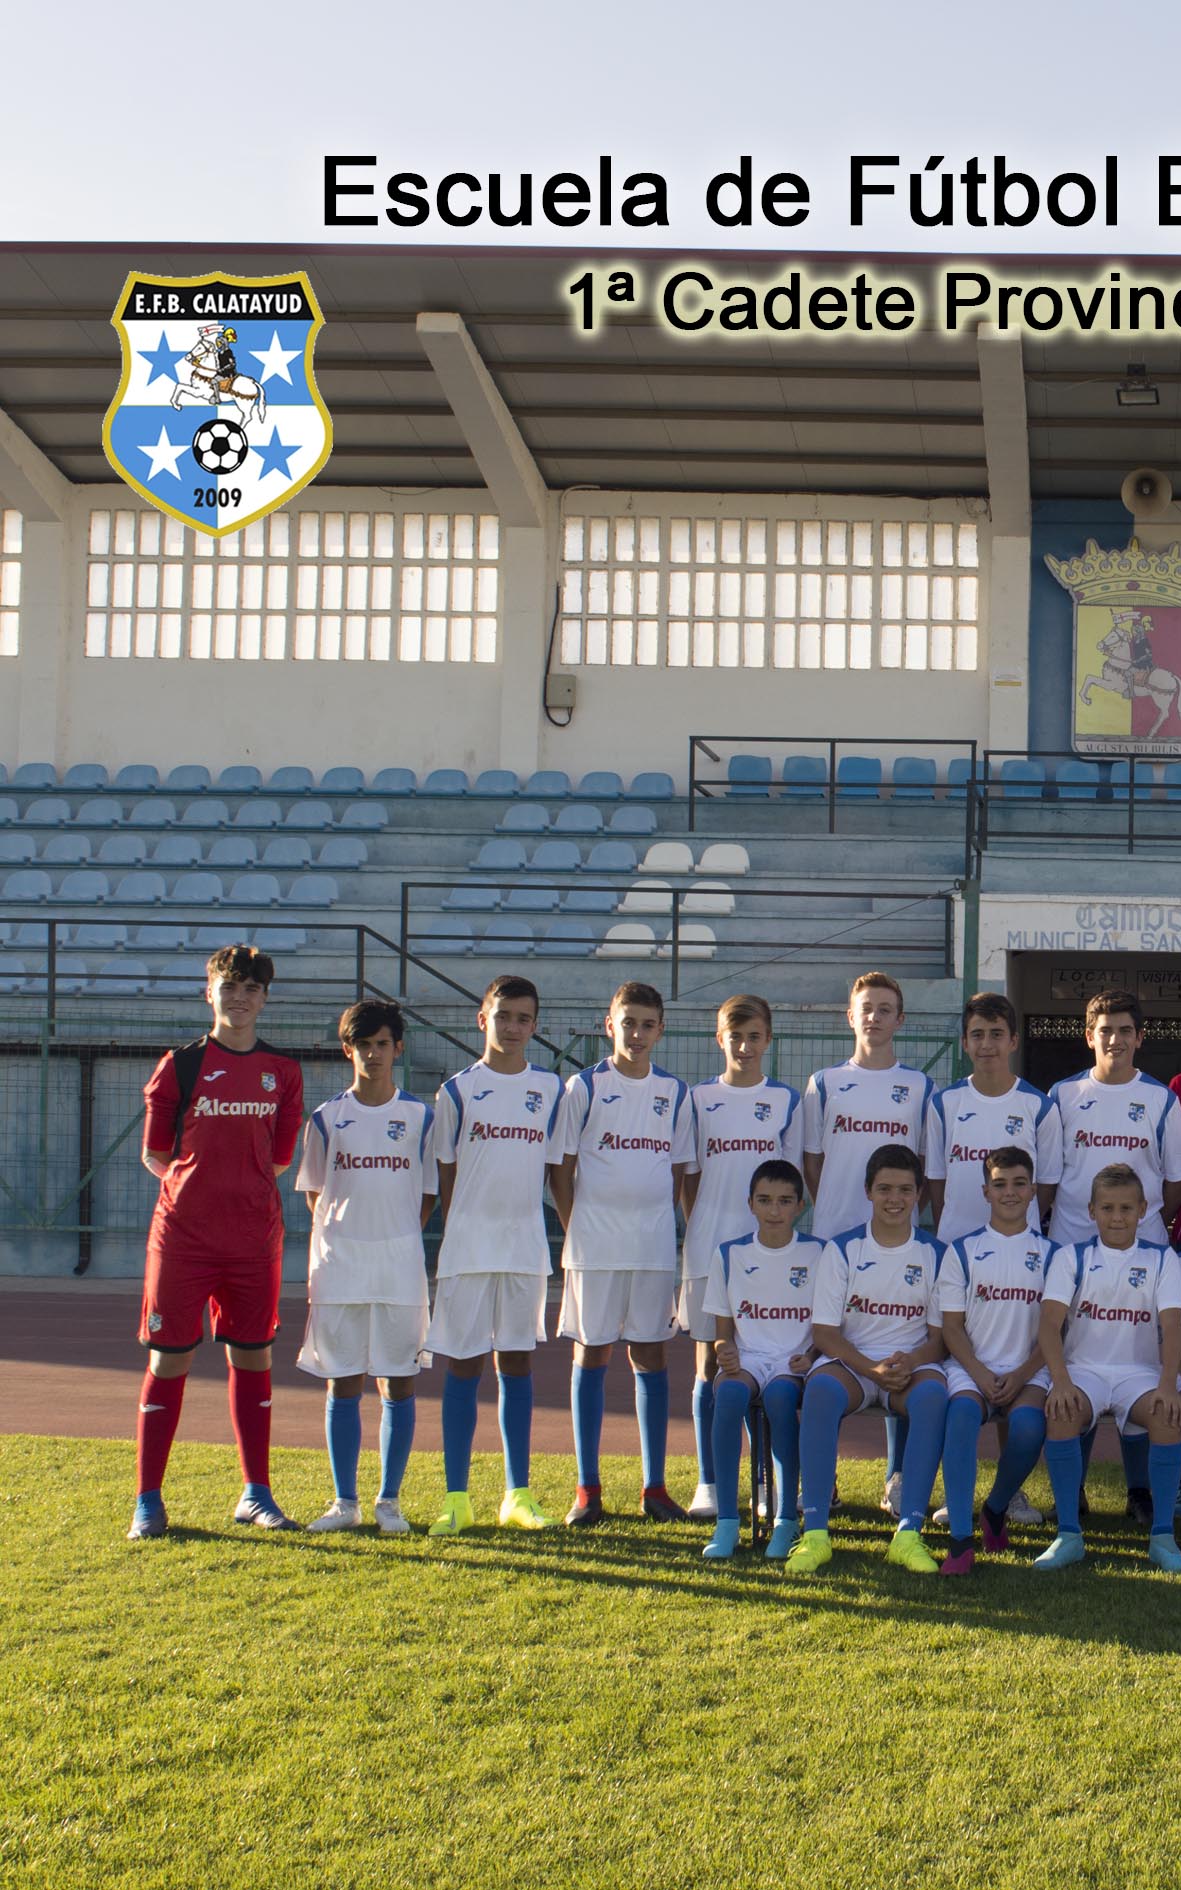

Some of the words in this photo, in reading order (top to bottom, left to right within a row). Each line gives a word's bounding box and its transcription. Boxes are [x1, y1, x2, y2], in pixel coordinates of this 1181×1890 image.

[1007, 930, 1128, 951] MUNICIPAL
[1058, 970, 1121, 983] LOCAL
[193, 1096, 277, 1119] Alcampo
[469, 1121, 545, 1144] Alcampo
[835, 1114, 909, 1138] Alcampo
[598, 1131, 672, 1154] Alcampo
[706, 1137, 775, 1158] Alcampo
[1075, 1129, 1149, 1152] Alcampo
[334, 1150, 411, 1172] Alcampo
[949, 1144, 992, 1163] Alca
[737, 1300, 813, 1323] Alcamp
[846, 1294, 924, 1320] Alcampo
[1076, 1300, 1152, 1326] Alcampo
